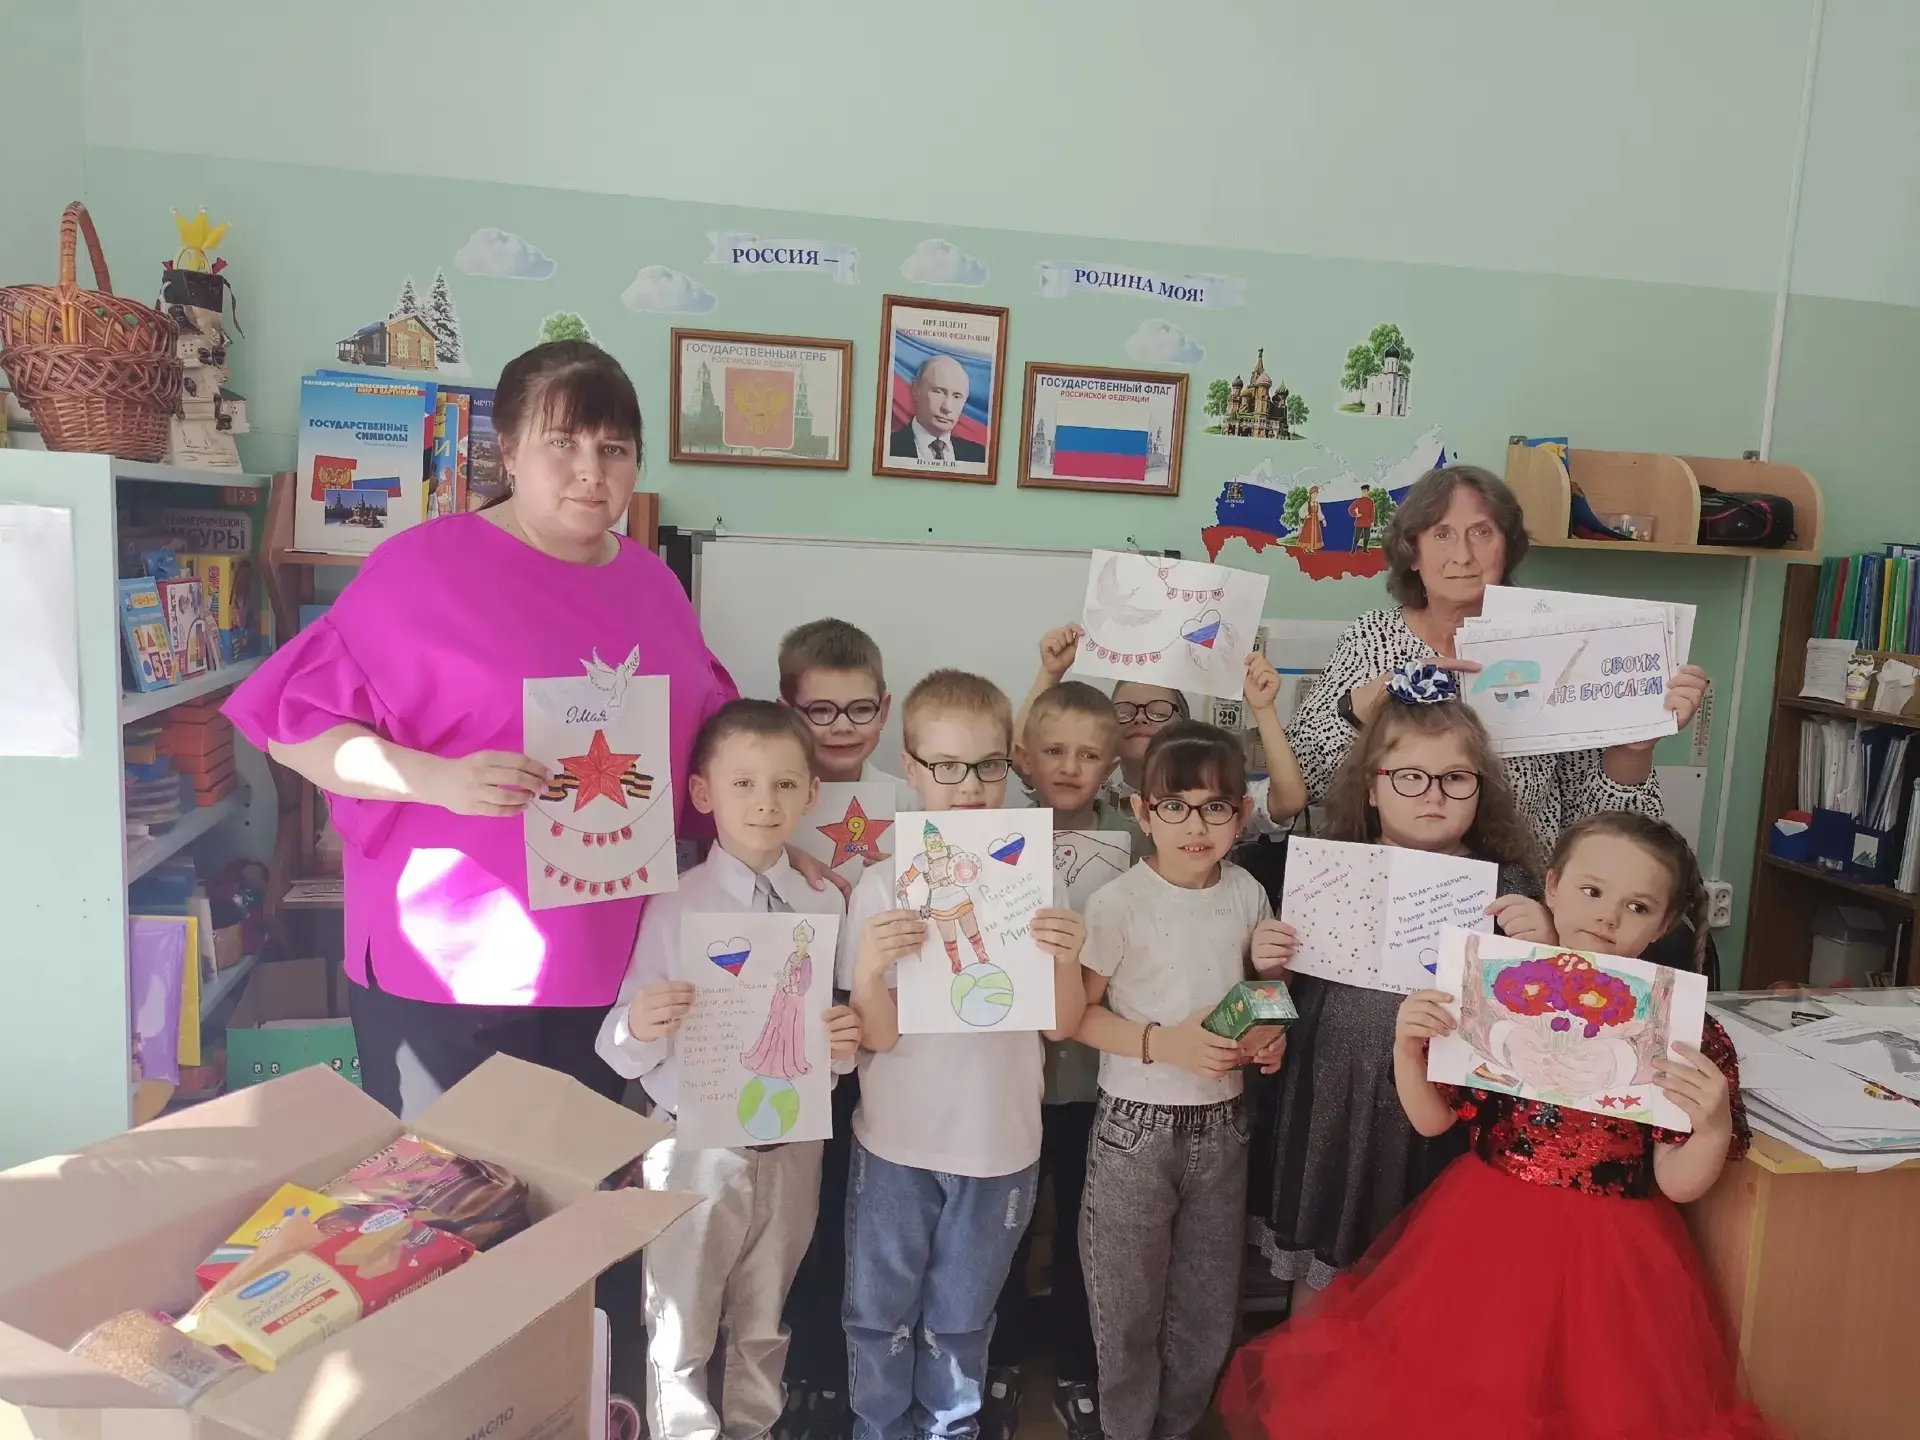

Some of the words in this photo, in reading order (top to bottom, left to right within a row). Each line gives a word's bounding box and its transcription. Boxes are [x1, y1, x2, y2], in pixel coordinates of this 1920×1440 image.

[731, 247, 819, 265] РОССИЯ
[1074, 269, 1154, 293] РОДИНА
[1158, 281, 1204, 302] МОЯ!
[922, 318, 969, 330] ПРЕЗИДЕНТ
[899, 328, 948, 339] РОССИЙСКОЙ
[948, 333, 991, 342] ФЕДЕРАЦИИ
[686, 342, 797, 360] ГОСУДАРСТВЕННЫЙ
[799, 350, 828, 362] ГЕРБ
[1041, 376, 1142, 394] ГОСУДАРСТВЕННЫЙ
[1144, 384, 1172, 396] ФЛАГ
[1060, 390, 1107, 400] РОССИЙСКОЙ
[1107, 393, 1150, 403] ФЕДЕРАЦИИ
[309, 418, 409, 433] ГОСУДАРСТВЕННЫЕ
[355, 431, 408, 443] СИМВОЛЫ
[1601, 653, 1660, 676] СВОИХ
[1553, 685, 1576, 704] НЕ
[1580, 676, 1663, 701] БРОСАЕМ
[1219, 711, 1236, 725] 29
[847, 816, 866, 842] 9
